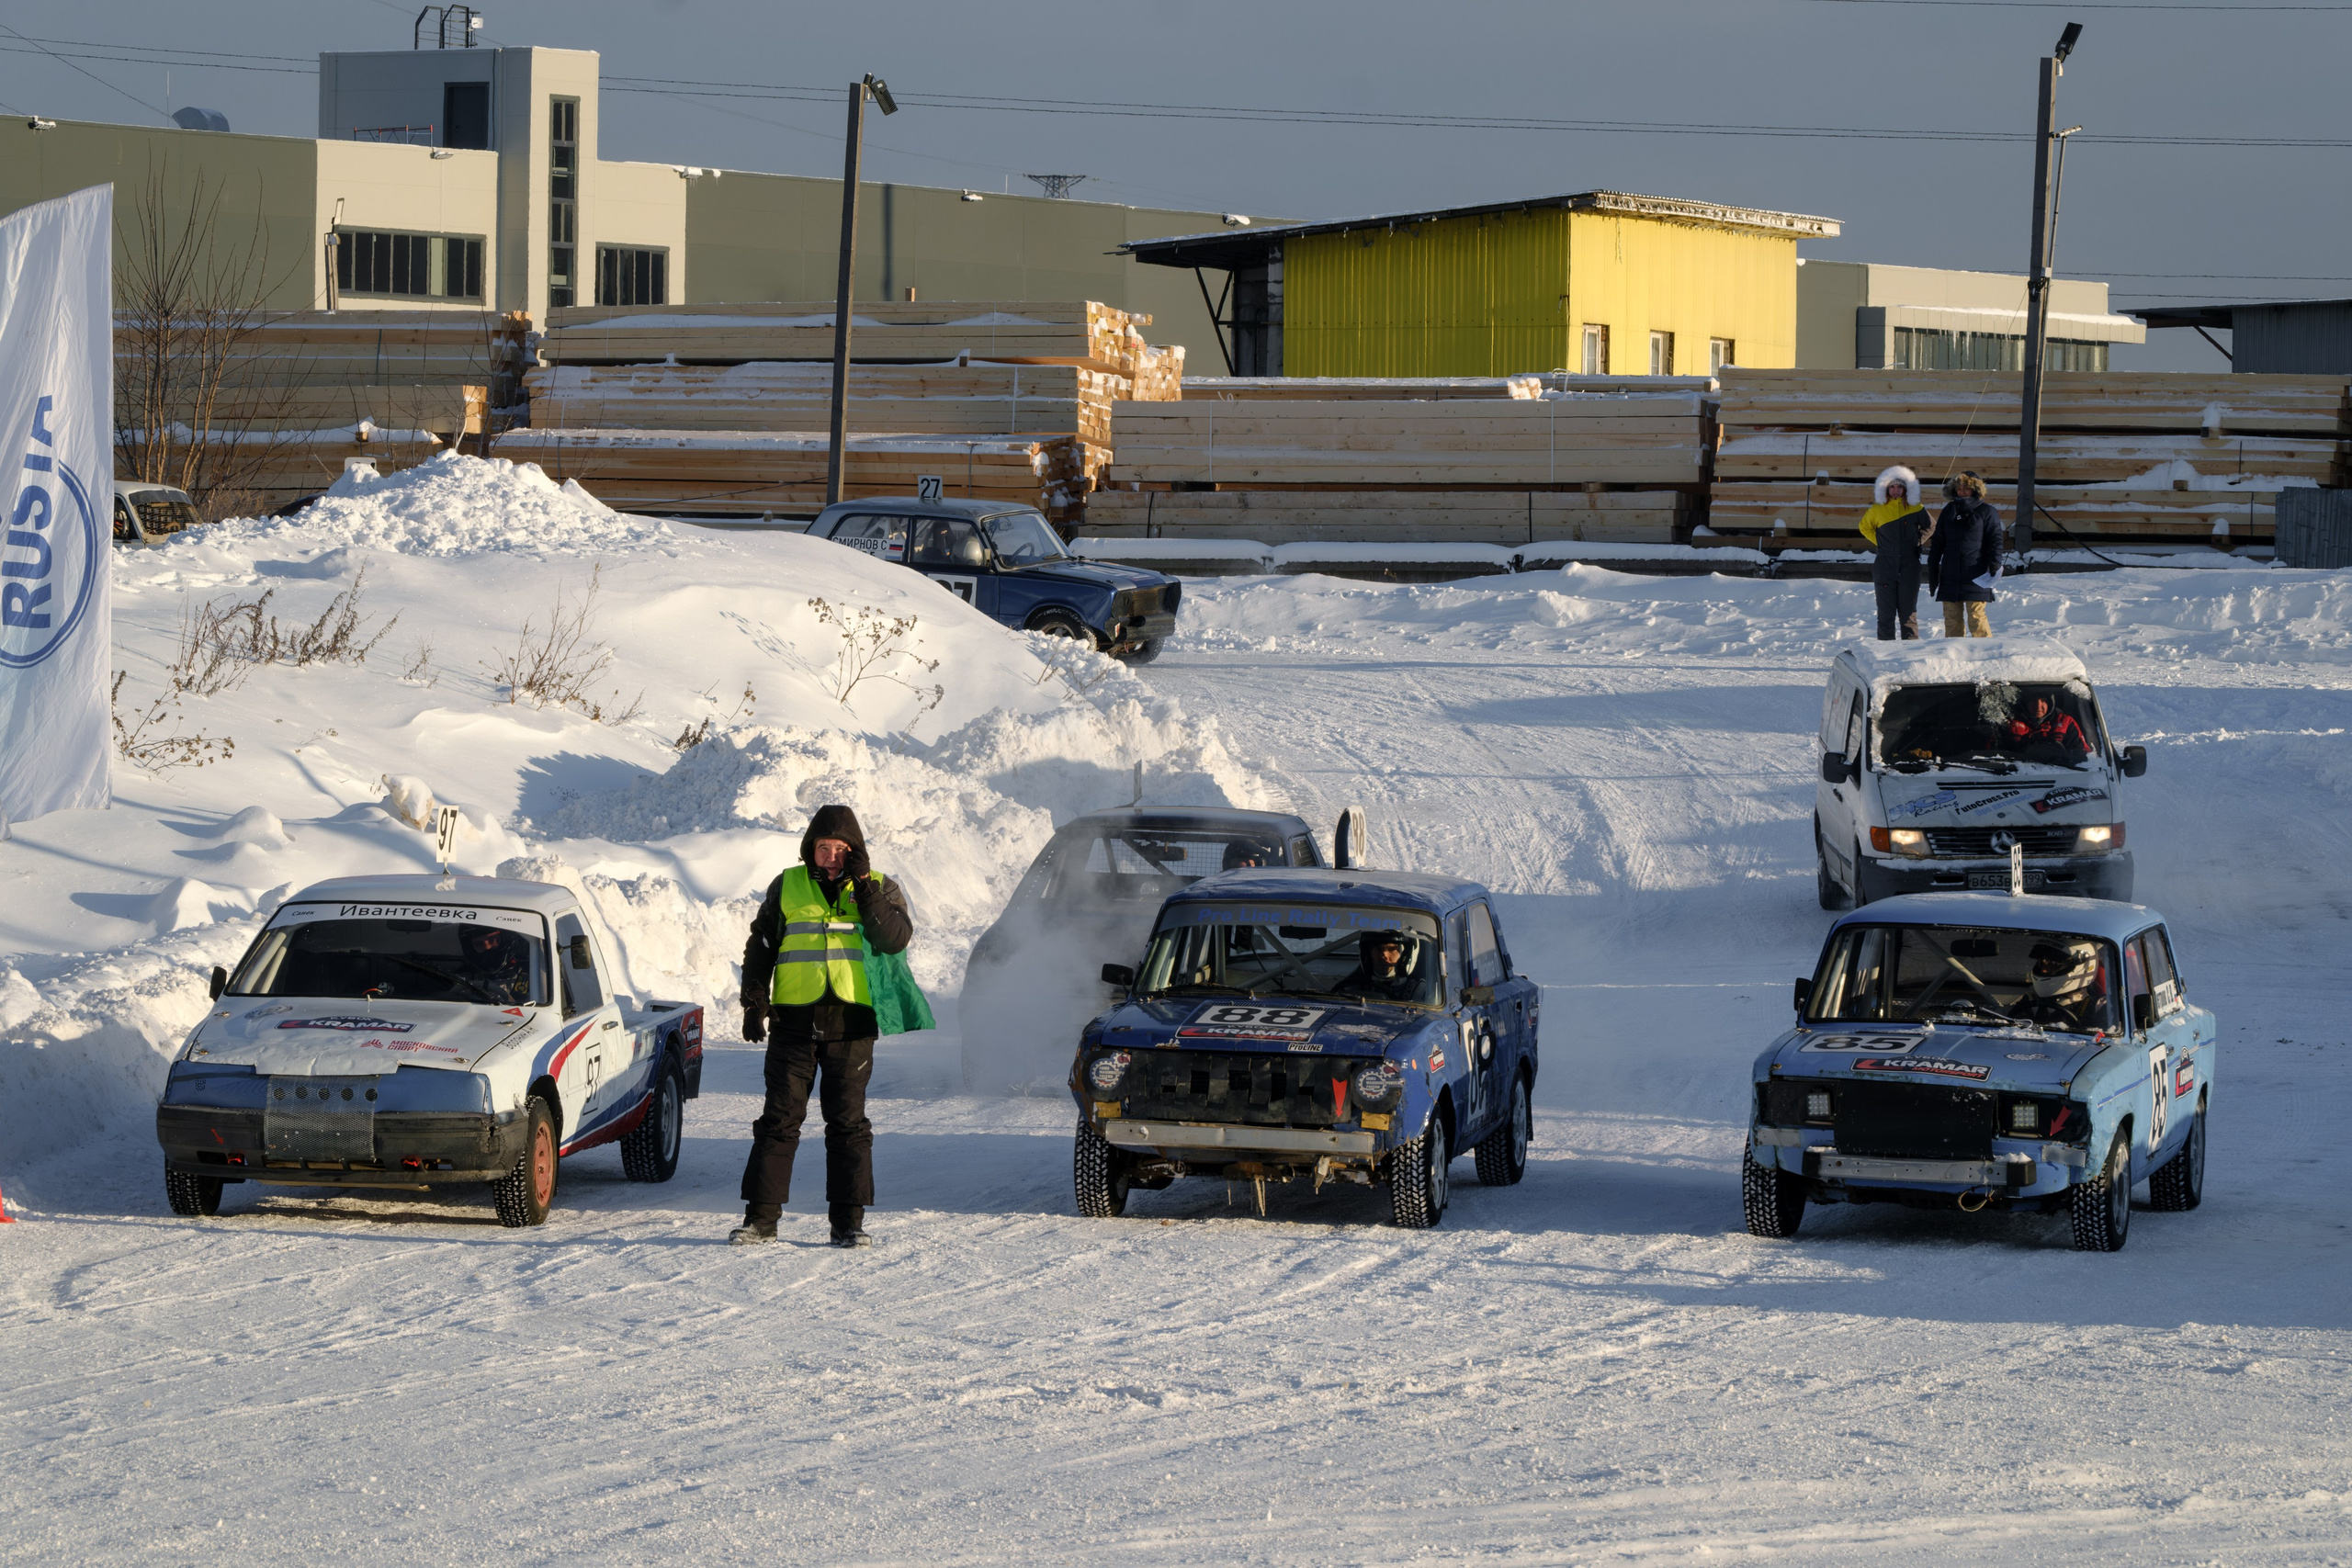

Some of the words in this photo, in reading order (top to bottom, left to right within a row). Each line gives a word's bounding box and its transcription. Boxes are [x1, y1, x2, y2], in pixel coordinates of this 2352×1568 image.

[920, 478, 940, 499] 27
[881, 540, 888, 550] С
[2046, 789, 2103, 806] KRAMAR
[1915, 801, 1960, 818] Racing
[438, 807, 458, 853] 97
[2013, 847, 2020, 888] 85
[1972, 874, 2012, 887] В653В
[339, 905, 477, 920] Ивантеевка
[1198, 908, 1233, 922] Pro
[1240, 908, 1281, 923] Line
[1288, 908, 1340, 930] Rally
[1348, 912, 1404, 931] Team
[1210, 1008, 1311, 1025] 88
[308, 1020, 411, 1030] KRAMAR
[1206, 1028, 1310, 1039] KRAMAR
[1288, 1043, 1323, 1052] ProLINE
[1814, 1037, 1911, 1050] 85
[1883, 1059, 1988, 1074] KRAMAR
[1911, 1066, 1984, 1078] MOTORSPORT
[586, 1055, 600, 1104] 97
[2152, 1059, 2167, 1142] 85
